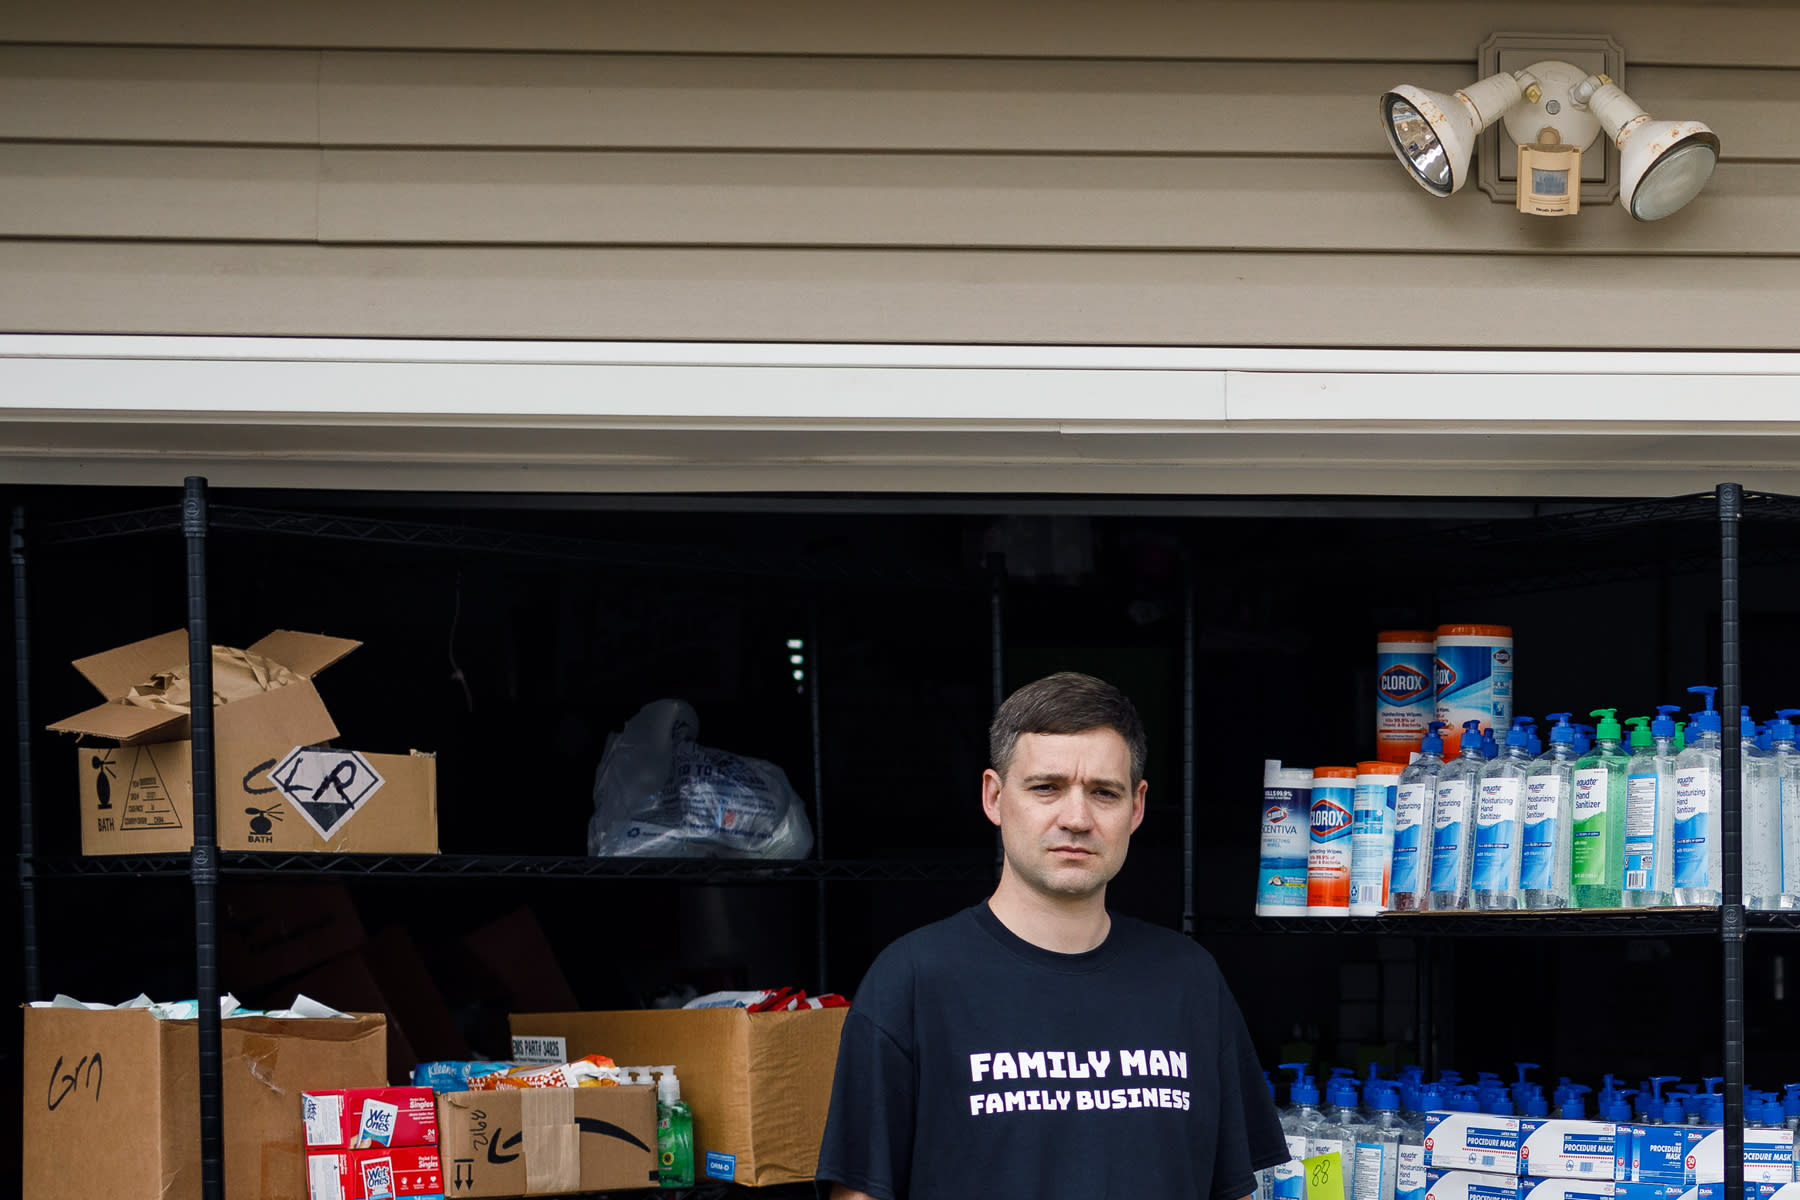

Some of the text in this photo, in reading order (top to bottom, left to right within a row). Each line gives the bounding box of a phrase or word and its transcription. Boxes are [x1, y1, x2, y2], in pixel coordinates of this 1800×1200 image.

[1381, 675, 1422, 691] CLOROX
[1576, 778, 1598, 788] equate
[1575, 800, 1601, 810] Sanitizer
[248, 835, 273, 843] BATH
[970, 1049, 1188, 1082] FAMILY MAN
[409, 1100, 434, 1109] Singles
[970, 1087, 1191, 1116] FAMILY BUSINESS
[369, 1109, 393, 1123] Wet
[366, 1118, 390, 1132] Ones
[1467, 1136, 1516, 1148] PROCEDURE MASK
[1564, 1143, 1614, 1153] PROCEDURE MASK
[1650, 1144, 1682, 1153] PROCEDURE
[1665, 1152, 1681, 1160] MASK
[1776, 1152, 1792, 1161] MASK
[418, 1160, 439, 1168] Singles
[710, 1161, 730, 1172] ORM-D
[368, 1167, 388, 1179] Wet
[368, 1176, 389, 1188] Ones
